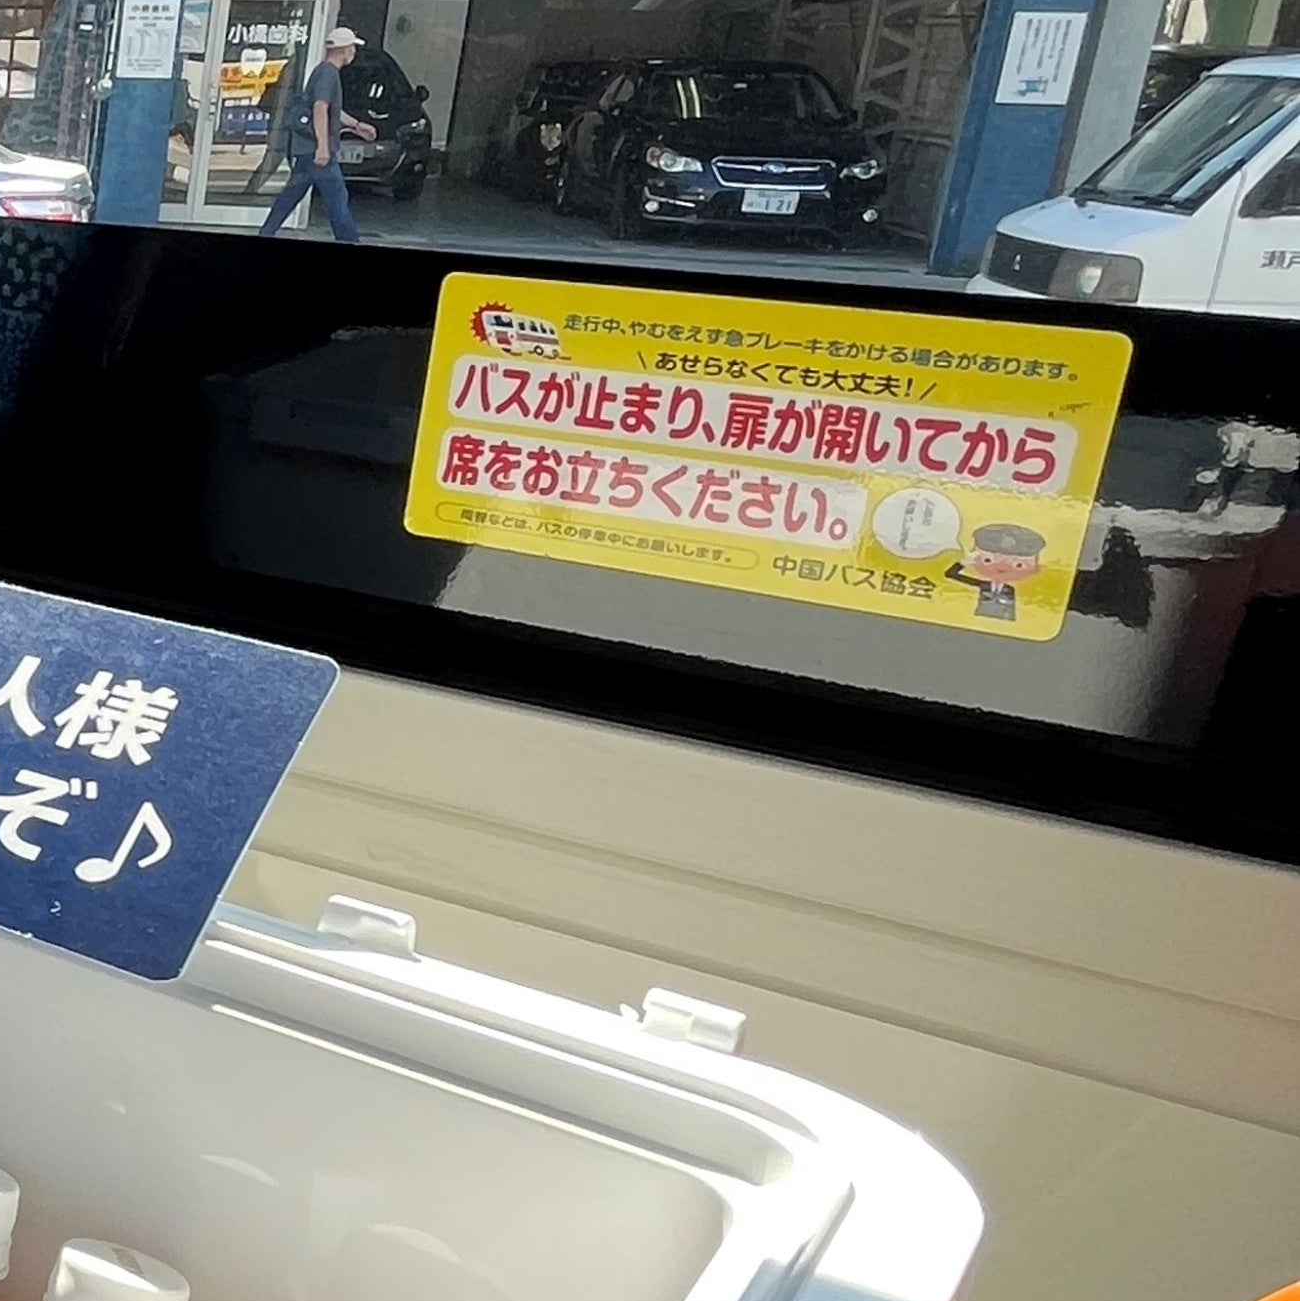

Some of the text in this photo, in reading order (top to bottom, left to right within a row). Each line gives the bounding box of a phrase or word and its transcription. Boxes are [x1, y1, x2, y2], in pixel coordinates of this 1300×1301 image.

[453, 363, 1059, 488] バスが止まり、扉が開いてから
[440, 435, 849, 543] 席をお立ちください。
[771, 553, 936, 601] 中国バス協会
